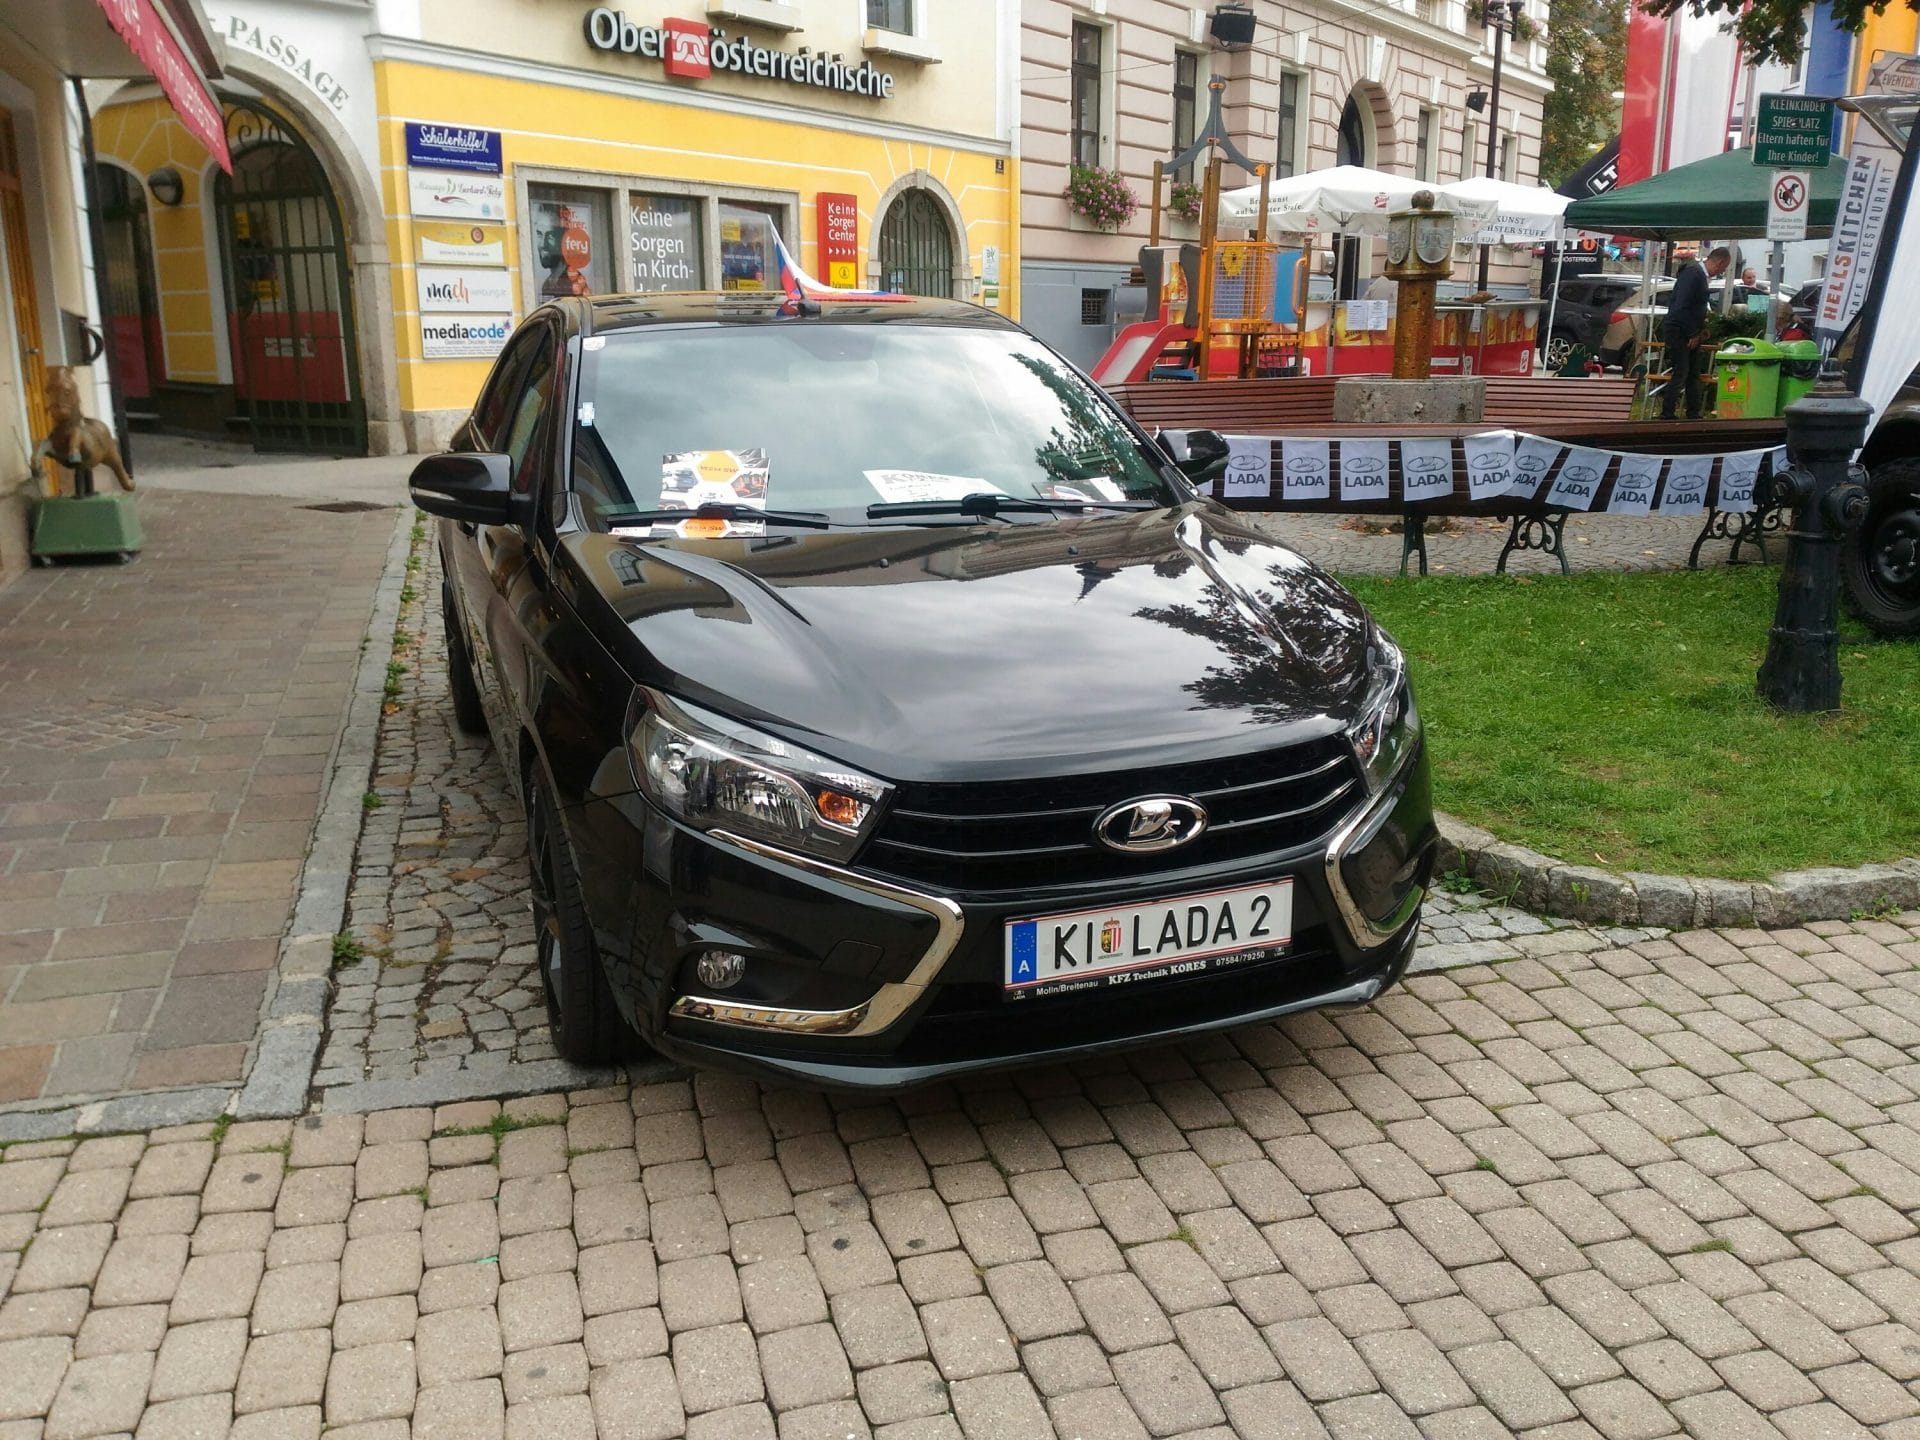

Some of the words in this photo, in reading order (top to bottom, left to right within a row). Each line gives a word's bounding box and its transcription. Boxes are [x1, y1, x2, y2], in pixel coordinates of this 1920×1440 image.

[586, 7, 669, 57] Ober
[709, 28, 895, 98] österreichische
[229, 15, 349, 111] PASSAGE
[1770, 99, 1826, 112] KLEINKINDER
[1772, 115, 1820, 129] SPIELATZ
[1758, 132, 1784, 145] Eltern
[1785, 134, 1814, 147] haften
[1816, 135, 1831, 147] für
[1767, 149, 1786, 161] Ihre
[1788, 150, 1819, 163] Kinder!
[1249, 196, 1288, 205] Brunst
[828, 202, 856, 215] Keine
[1861, 167, 1894, 258] RESTAURANT
[630, 205, 673, 228] Keine
[828, 214, 856, 230] Sorgen
[828, 229, 856, 242] Center
[631, 232, 684, 258] Sorgen
[633, 257, 648, 277] in
[651, 259, 694, 279] Kirch-
[423, 323, 505, 340] mediacode
[1228, 473, 1266, 485] LADA
[1286, 475, 1325, 488] LADA
[1344, 475, 1385, 488] LADA
[1407, 473, 1449, 488] LADA
[1473, 470, 1511, 486] LADA
[1513, 473, 1537, 488] ADA
[1554, 481, 1590, 498] LADA
[1722, 490, 1753, 501] LAD
[1665, 492, 1701, 505] LADA
[1018, 959, 1030, 974] A
[1054, 922, 1093, 970] KI
[1132, 901, 1238, 957] LADA
[1249, 894, 1271, 938] 2
[1108, 973, 1131, 985] KFZ
[1133, 967, 1169, 982] Technik
[1170, 961, 1207, 975] KORES
